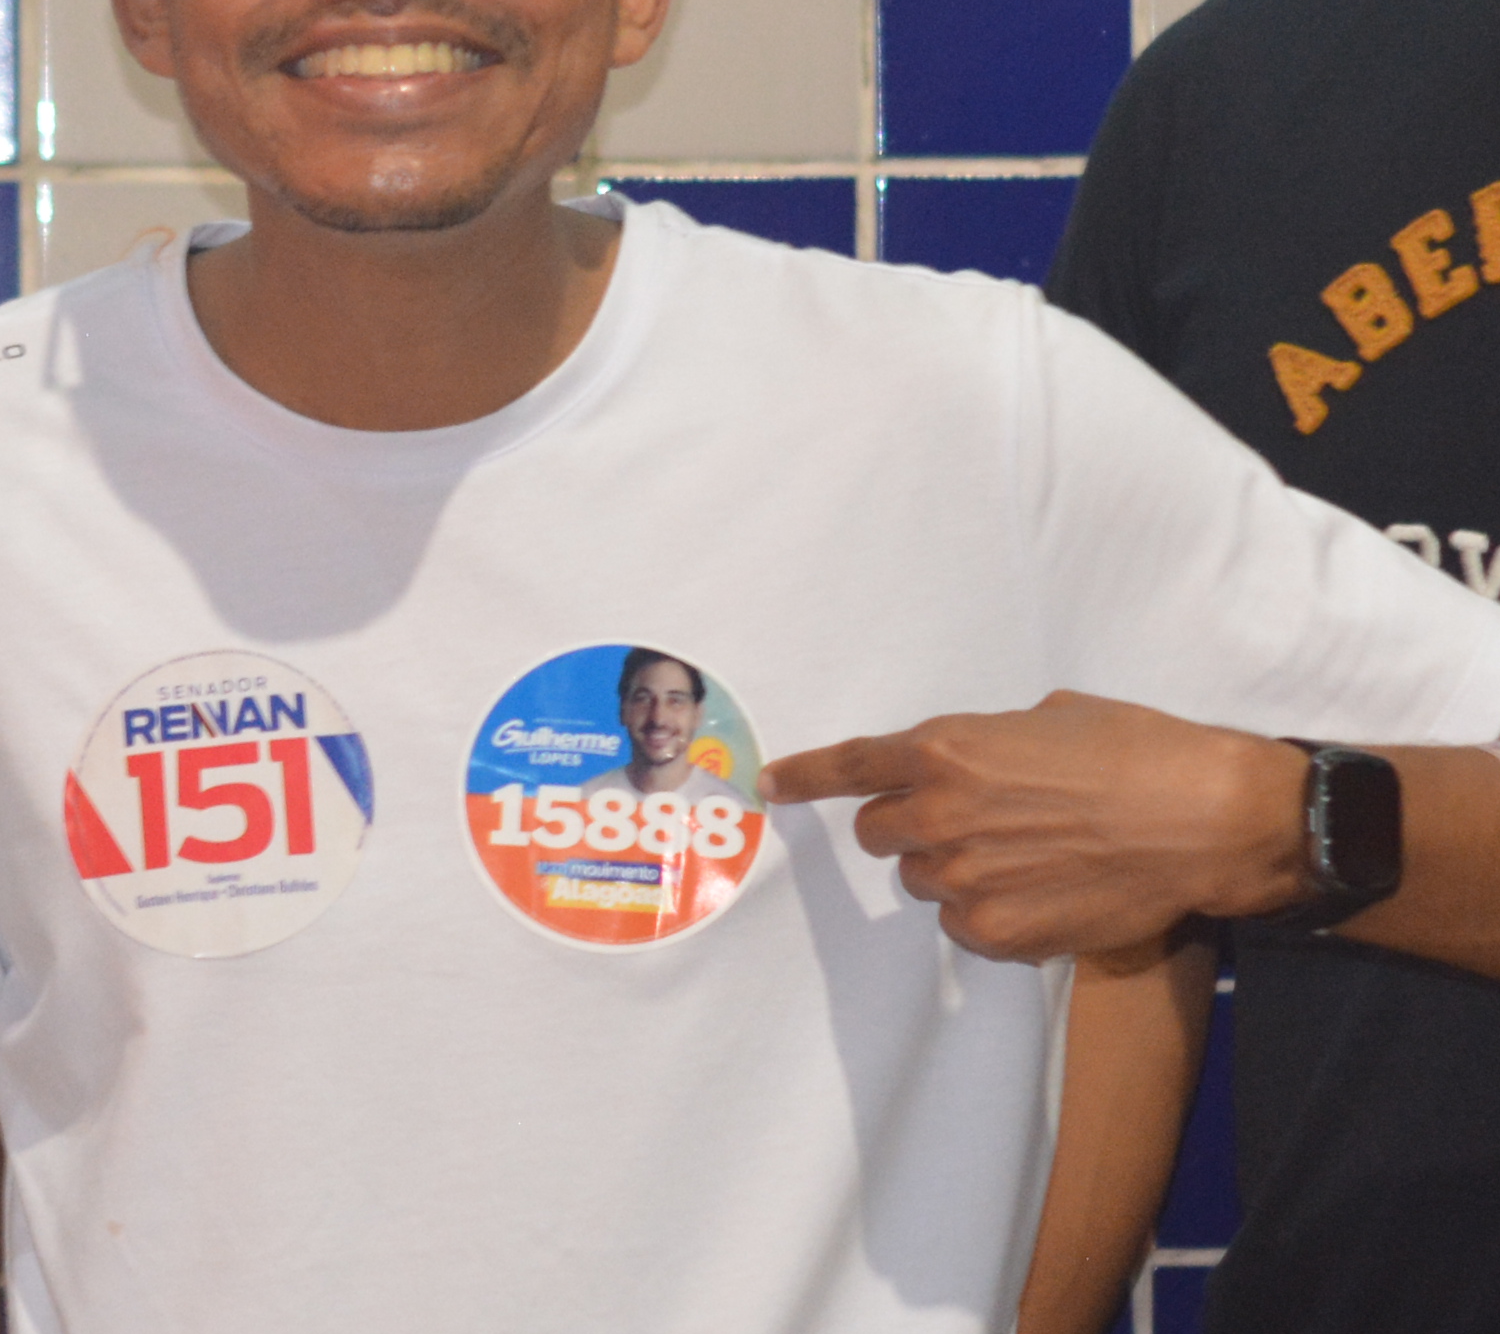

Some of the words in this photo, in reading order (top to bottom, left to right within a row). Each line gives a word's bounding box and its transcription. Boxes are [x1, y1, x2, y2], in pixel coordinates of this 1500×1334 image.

[157, 675, 269, 701] SENADOR
[123, 691, 308, 748] RENAN
[490, 719, 621, 751] Guilherme
[124, 736, 316, 870] 151
[488, 782, 746, 859] 15888
